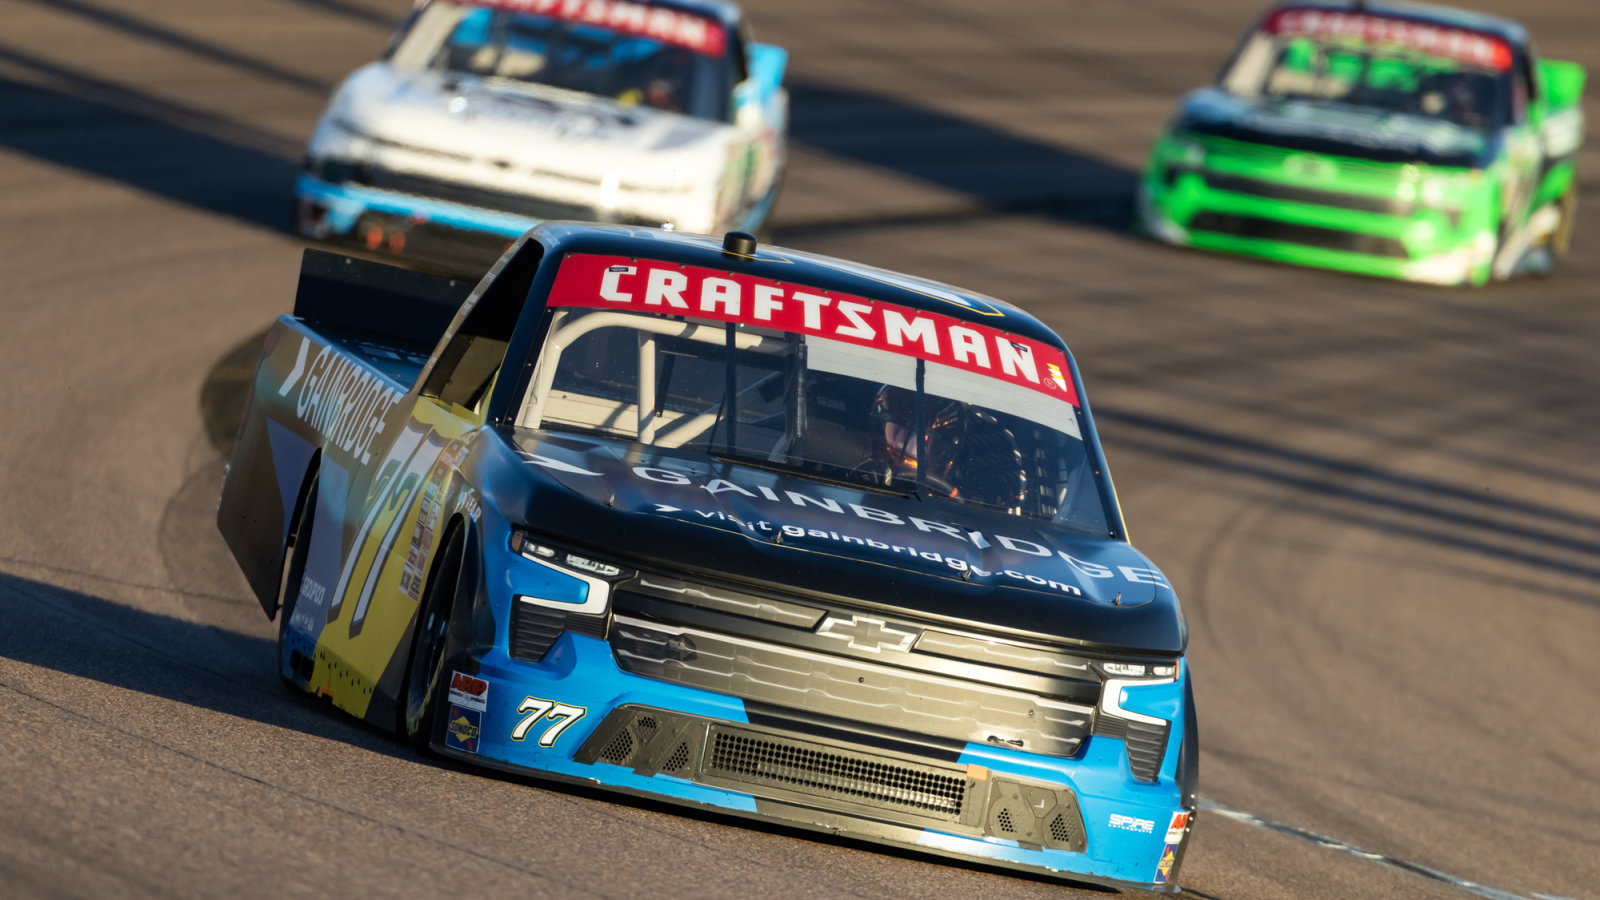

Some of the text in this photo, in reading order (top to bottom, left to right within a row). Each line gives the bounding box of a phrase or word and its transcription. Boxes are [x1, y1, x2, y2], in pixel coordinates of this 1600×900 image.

[600, 264, 1040, 385] CRAFTSMAN
[297, 345, 405, 467] GAINBRIDGE
[327, 415, 450, 639] 77
[632, 467, 1169, 589] GAINBRIDGE
[695, 509, 1081, 596] visit gainbridge.com
[451, 673, 487, 696] ARP
[511, 695, 587, 748] 77
[451, 721, 477, 737] SUNOCO
[1109, 813, 1155, 830] SPIRE
